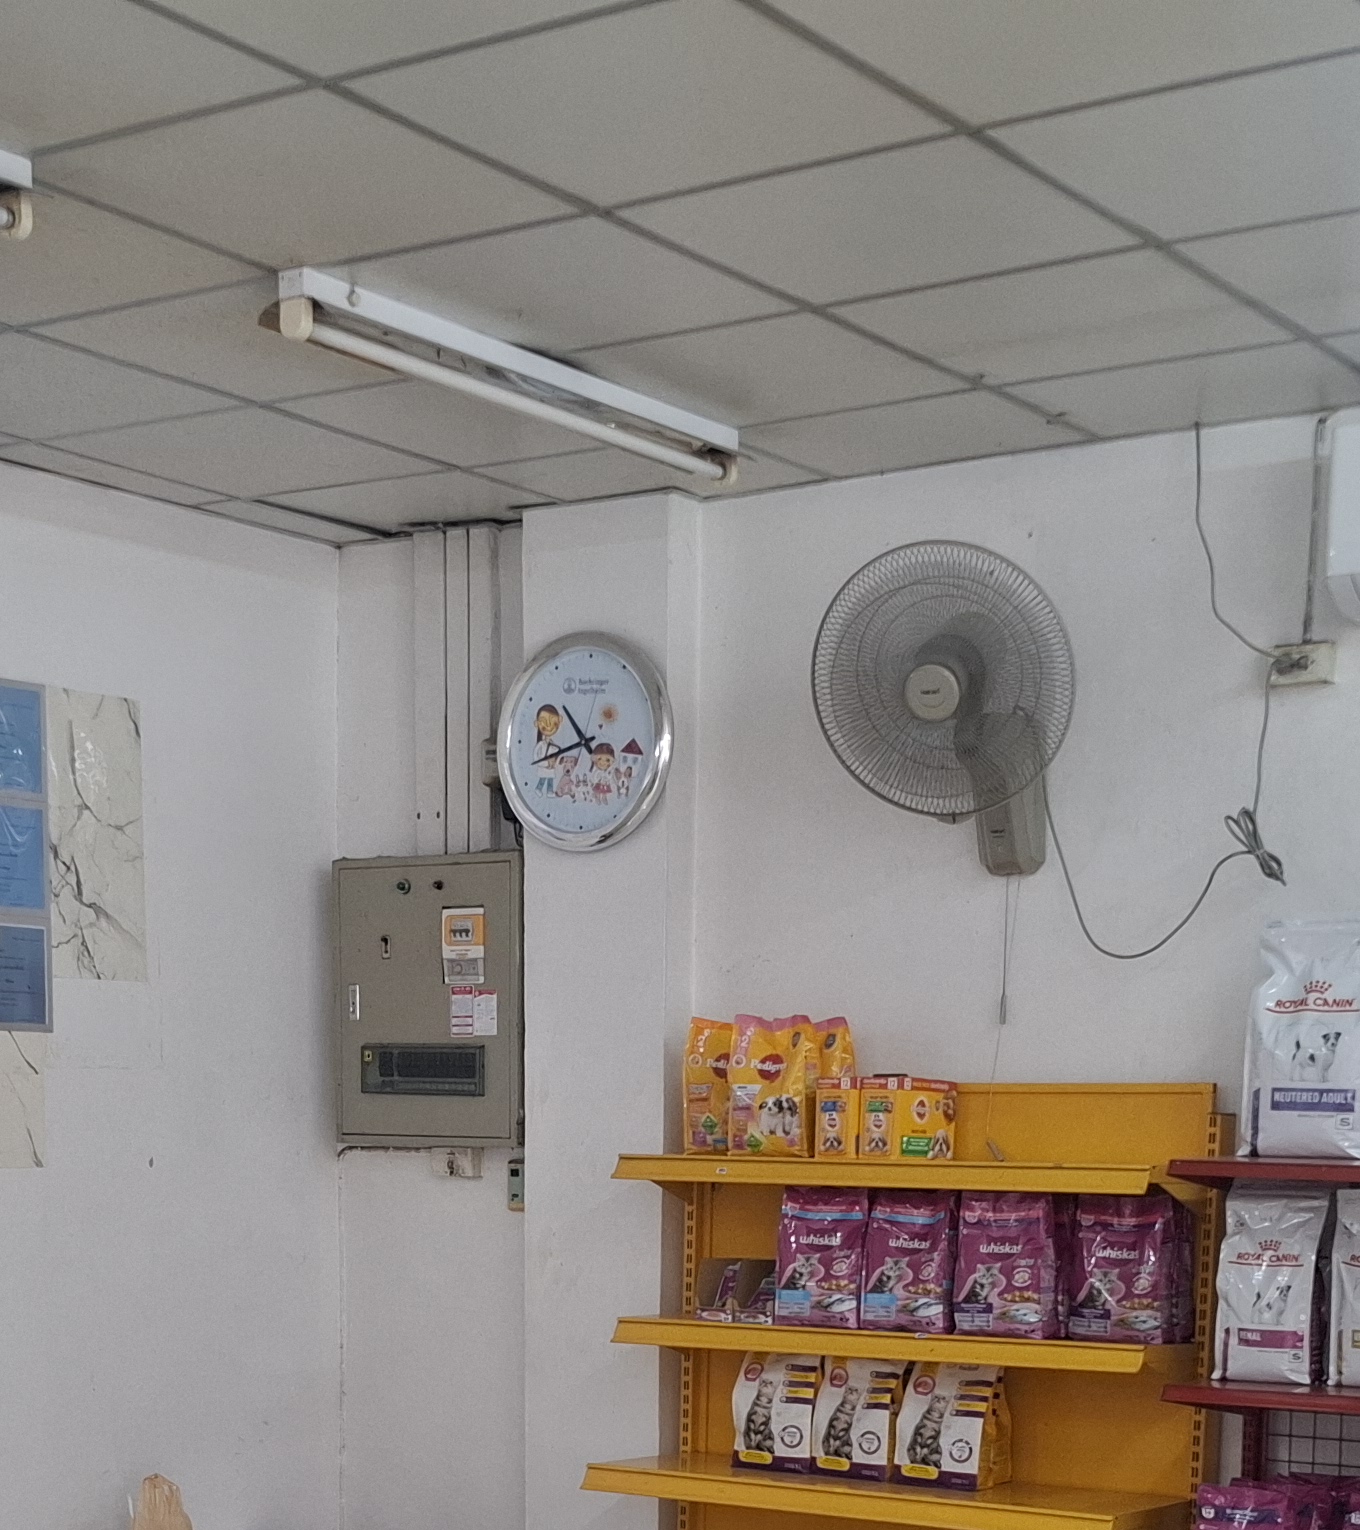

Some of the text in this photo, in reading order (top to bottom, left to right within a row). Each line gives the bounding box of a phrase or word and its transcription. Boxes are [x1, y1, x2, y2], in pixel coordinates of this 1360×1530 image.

[1275, 997, 1354, 1009] ROYAL CANIN
[1273, 1091, 1352, 1103] NEUTERED ADULT
[1338, 1117, 1350, 1127] S
[799, 1233, 842, 1246] whiskas
[889, 1237, 931, 1249] whiskas
[979, 1242, 1022, 1254] whiskas
[1096, 1247, 1139, 1260] whiskas
[1236, 1252, 1299, 1263] ROYAL CANIN
